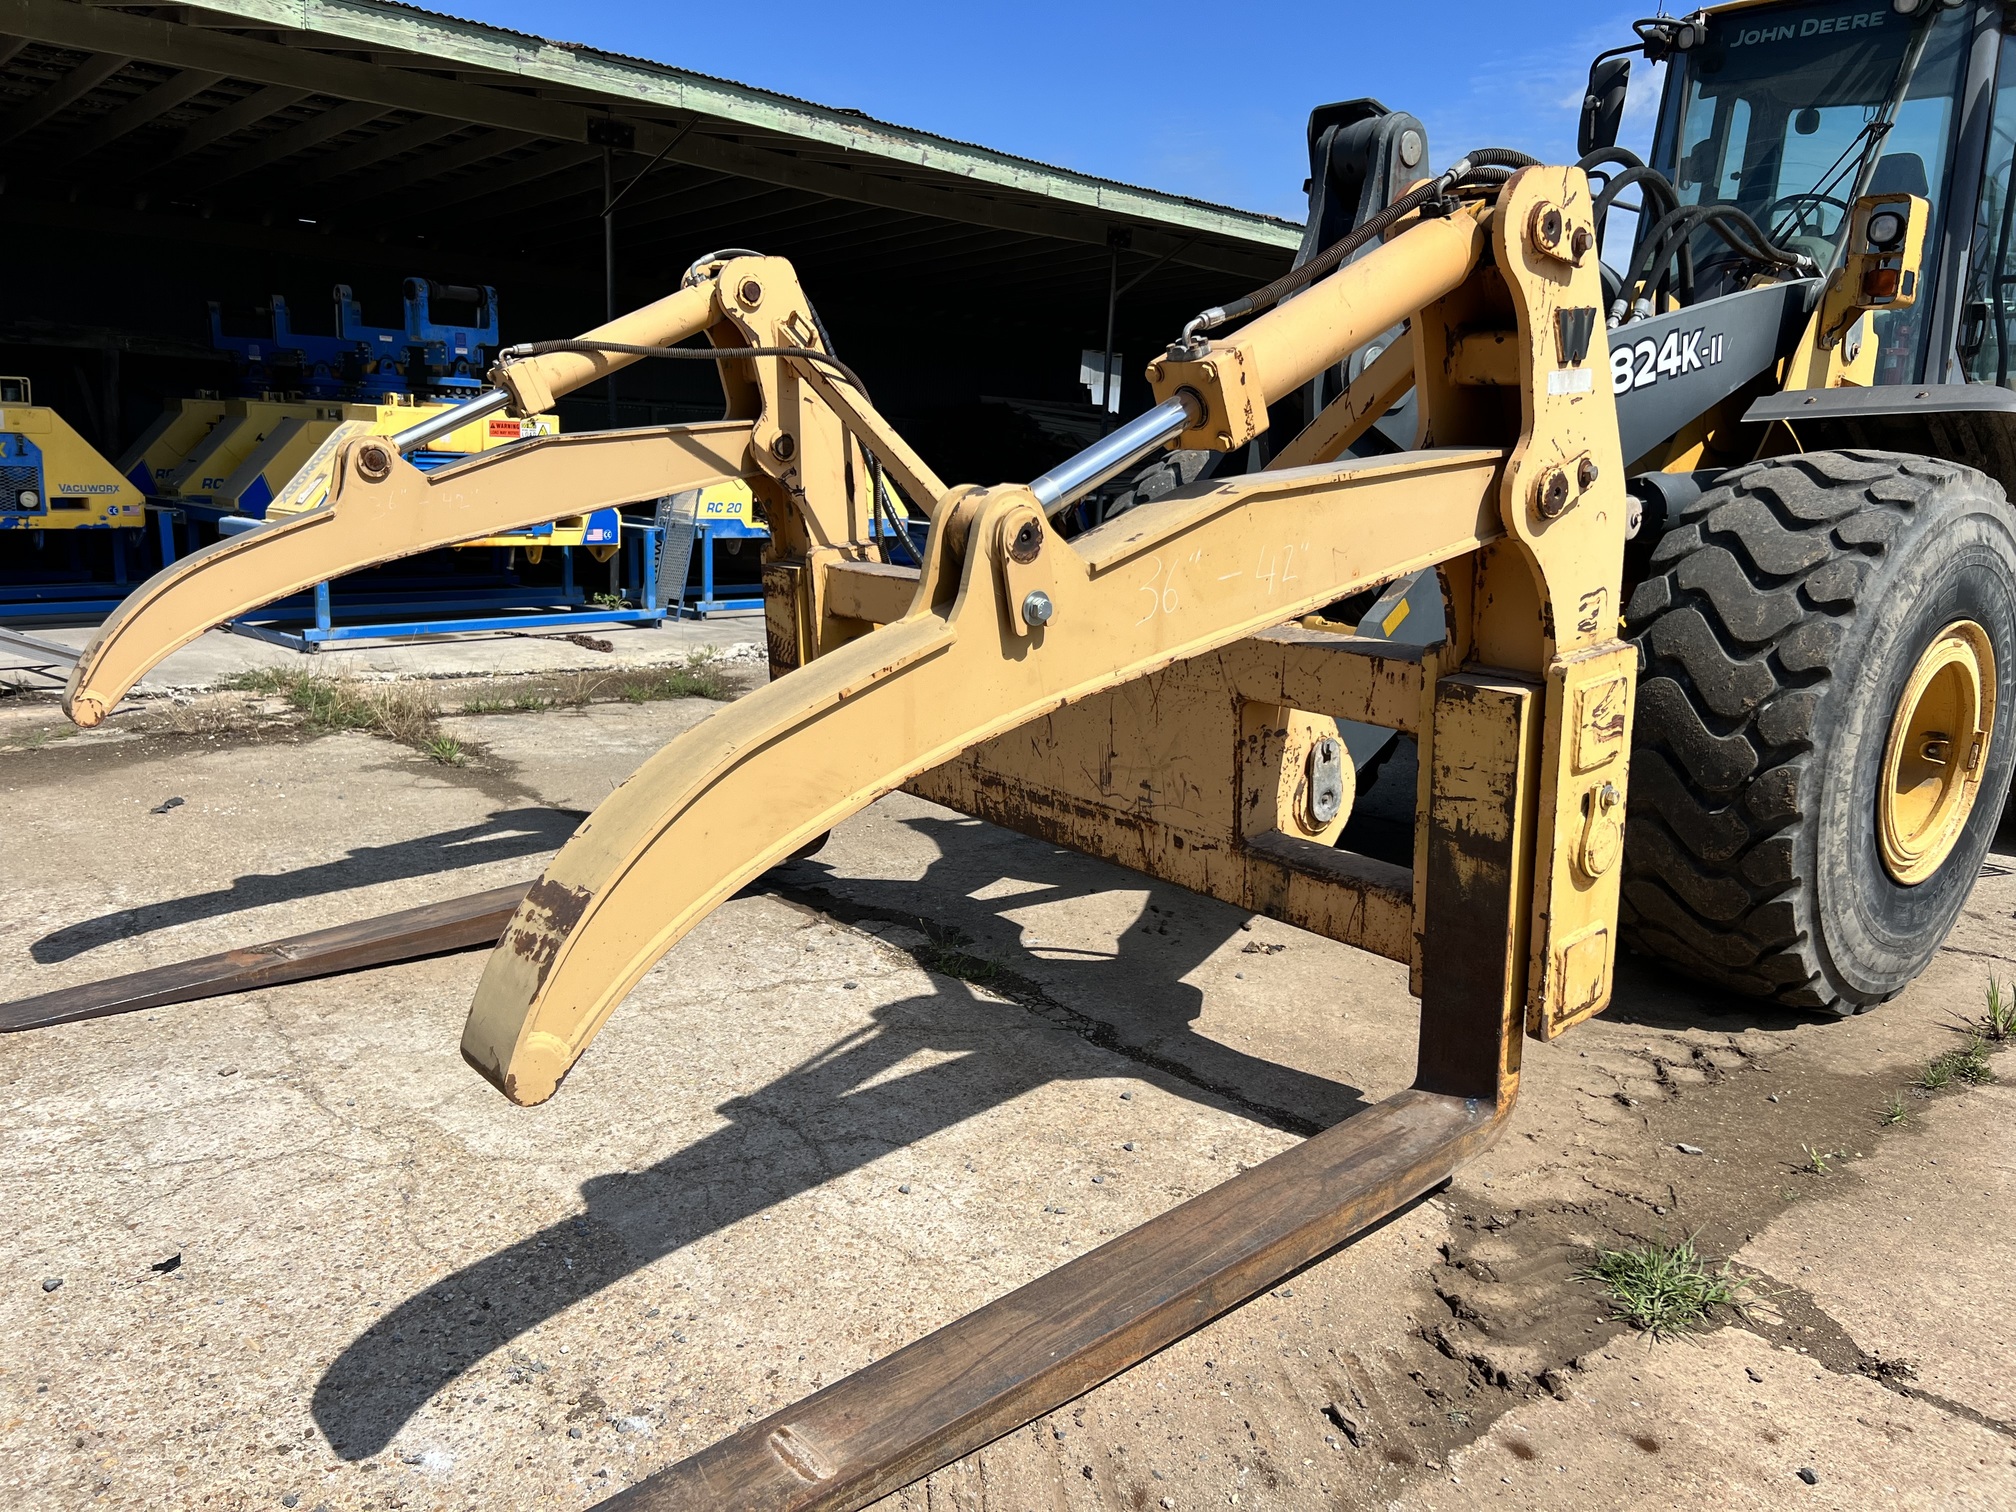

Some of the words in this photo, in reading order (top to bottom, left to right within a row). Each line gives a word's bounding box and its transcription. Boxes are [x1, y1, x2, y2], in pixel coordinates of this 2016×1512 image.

[1730, 24, 1796, 48] JOHN
[1799, 10, 1887, 38] DEERE
[1610, 327, 1723, 397] 824K-II
[58, 484, 120, 494] VACUWORX
[202, 478, 224, 489] RC
[706, 502, 724, 513] RC
[727, 502, 742, 513] 20
[1255, 542, 1310, 596] 42"
